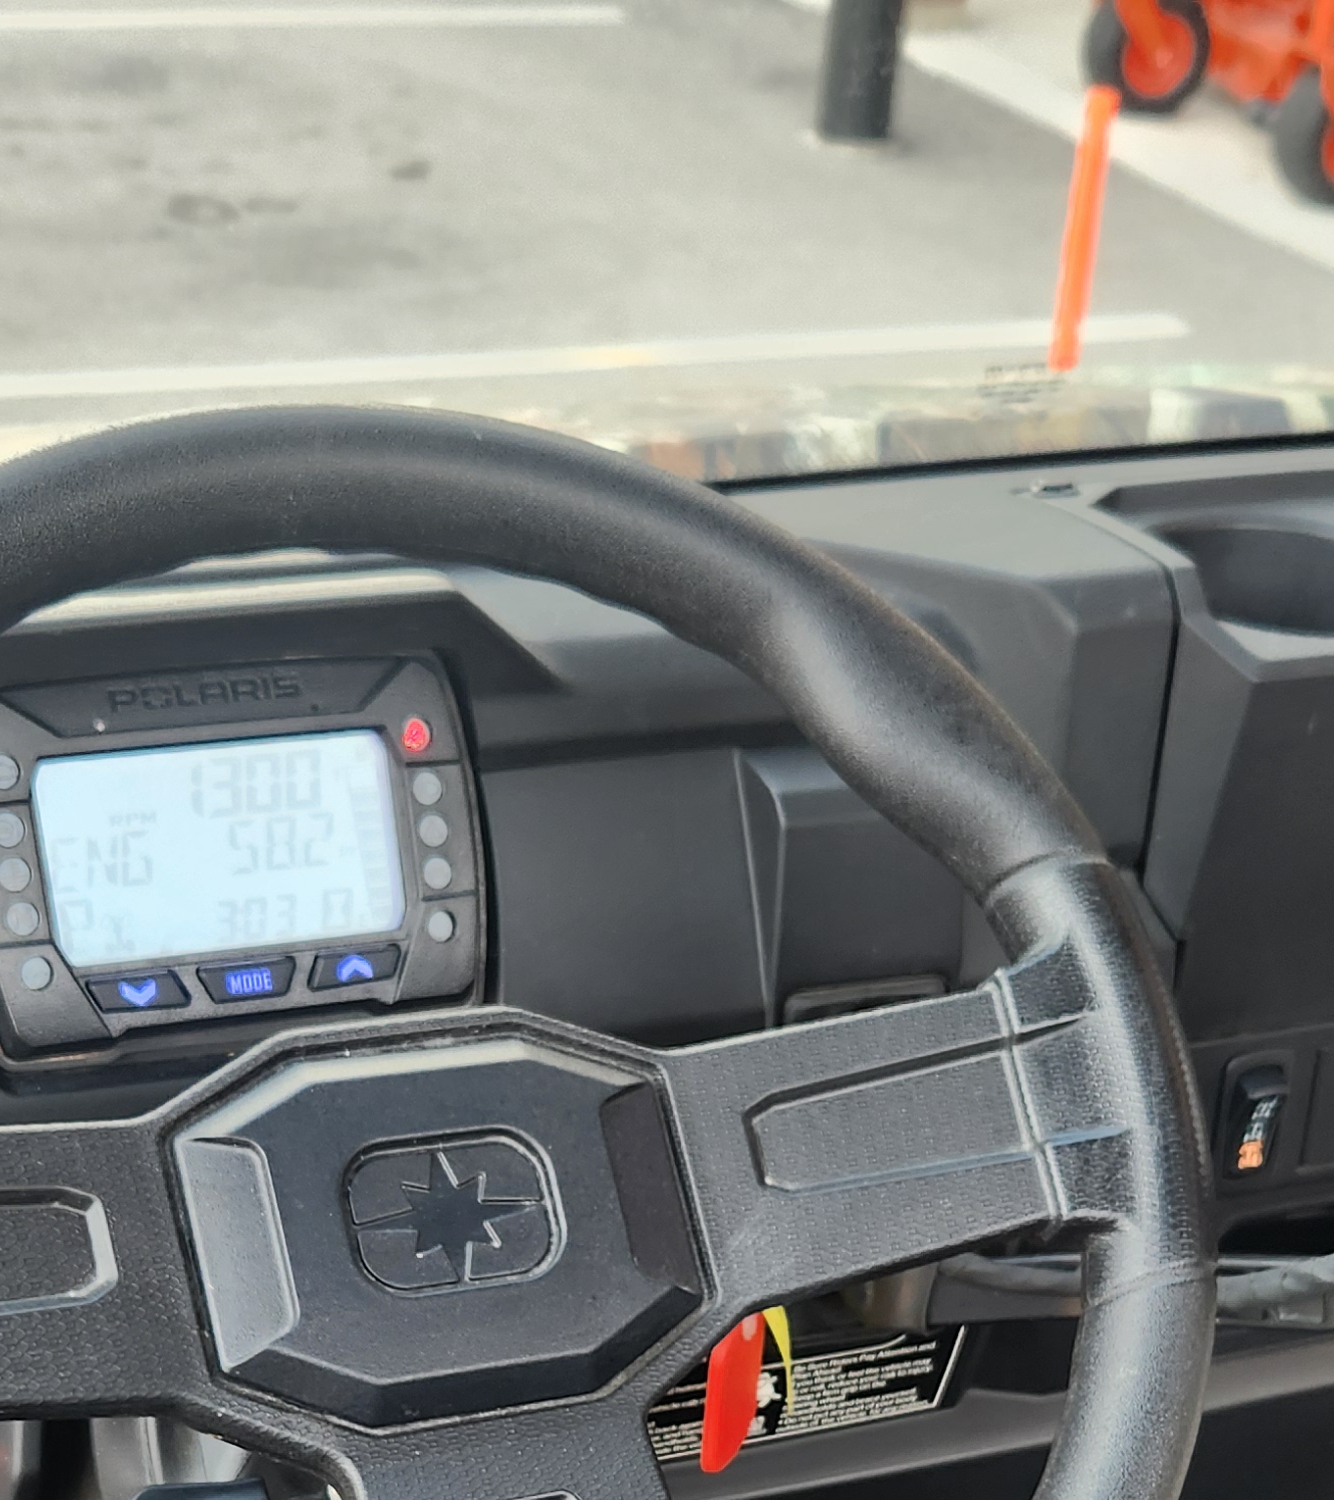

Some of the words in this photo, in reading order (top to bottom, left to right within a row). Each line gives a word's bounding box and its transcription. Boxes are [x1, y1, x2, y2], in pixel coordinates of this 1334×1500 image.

[106, 675, 303, 714] POLARIS
[190, 749, 321, 818] 1300
[109, 811, 157, 827] RPM
[228, 969, 273, 995] MODE
